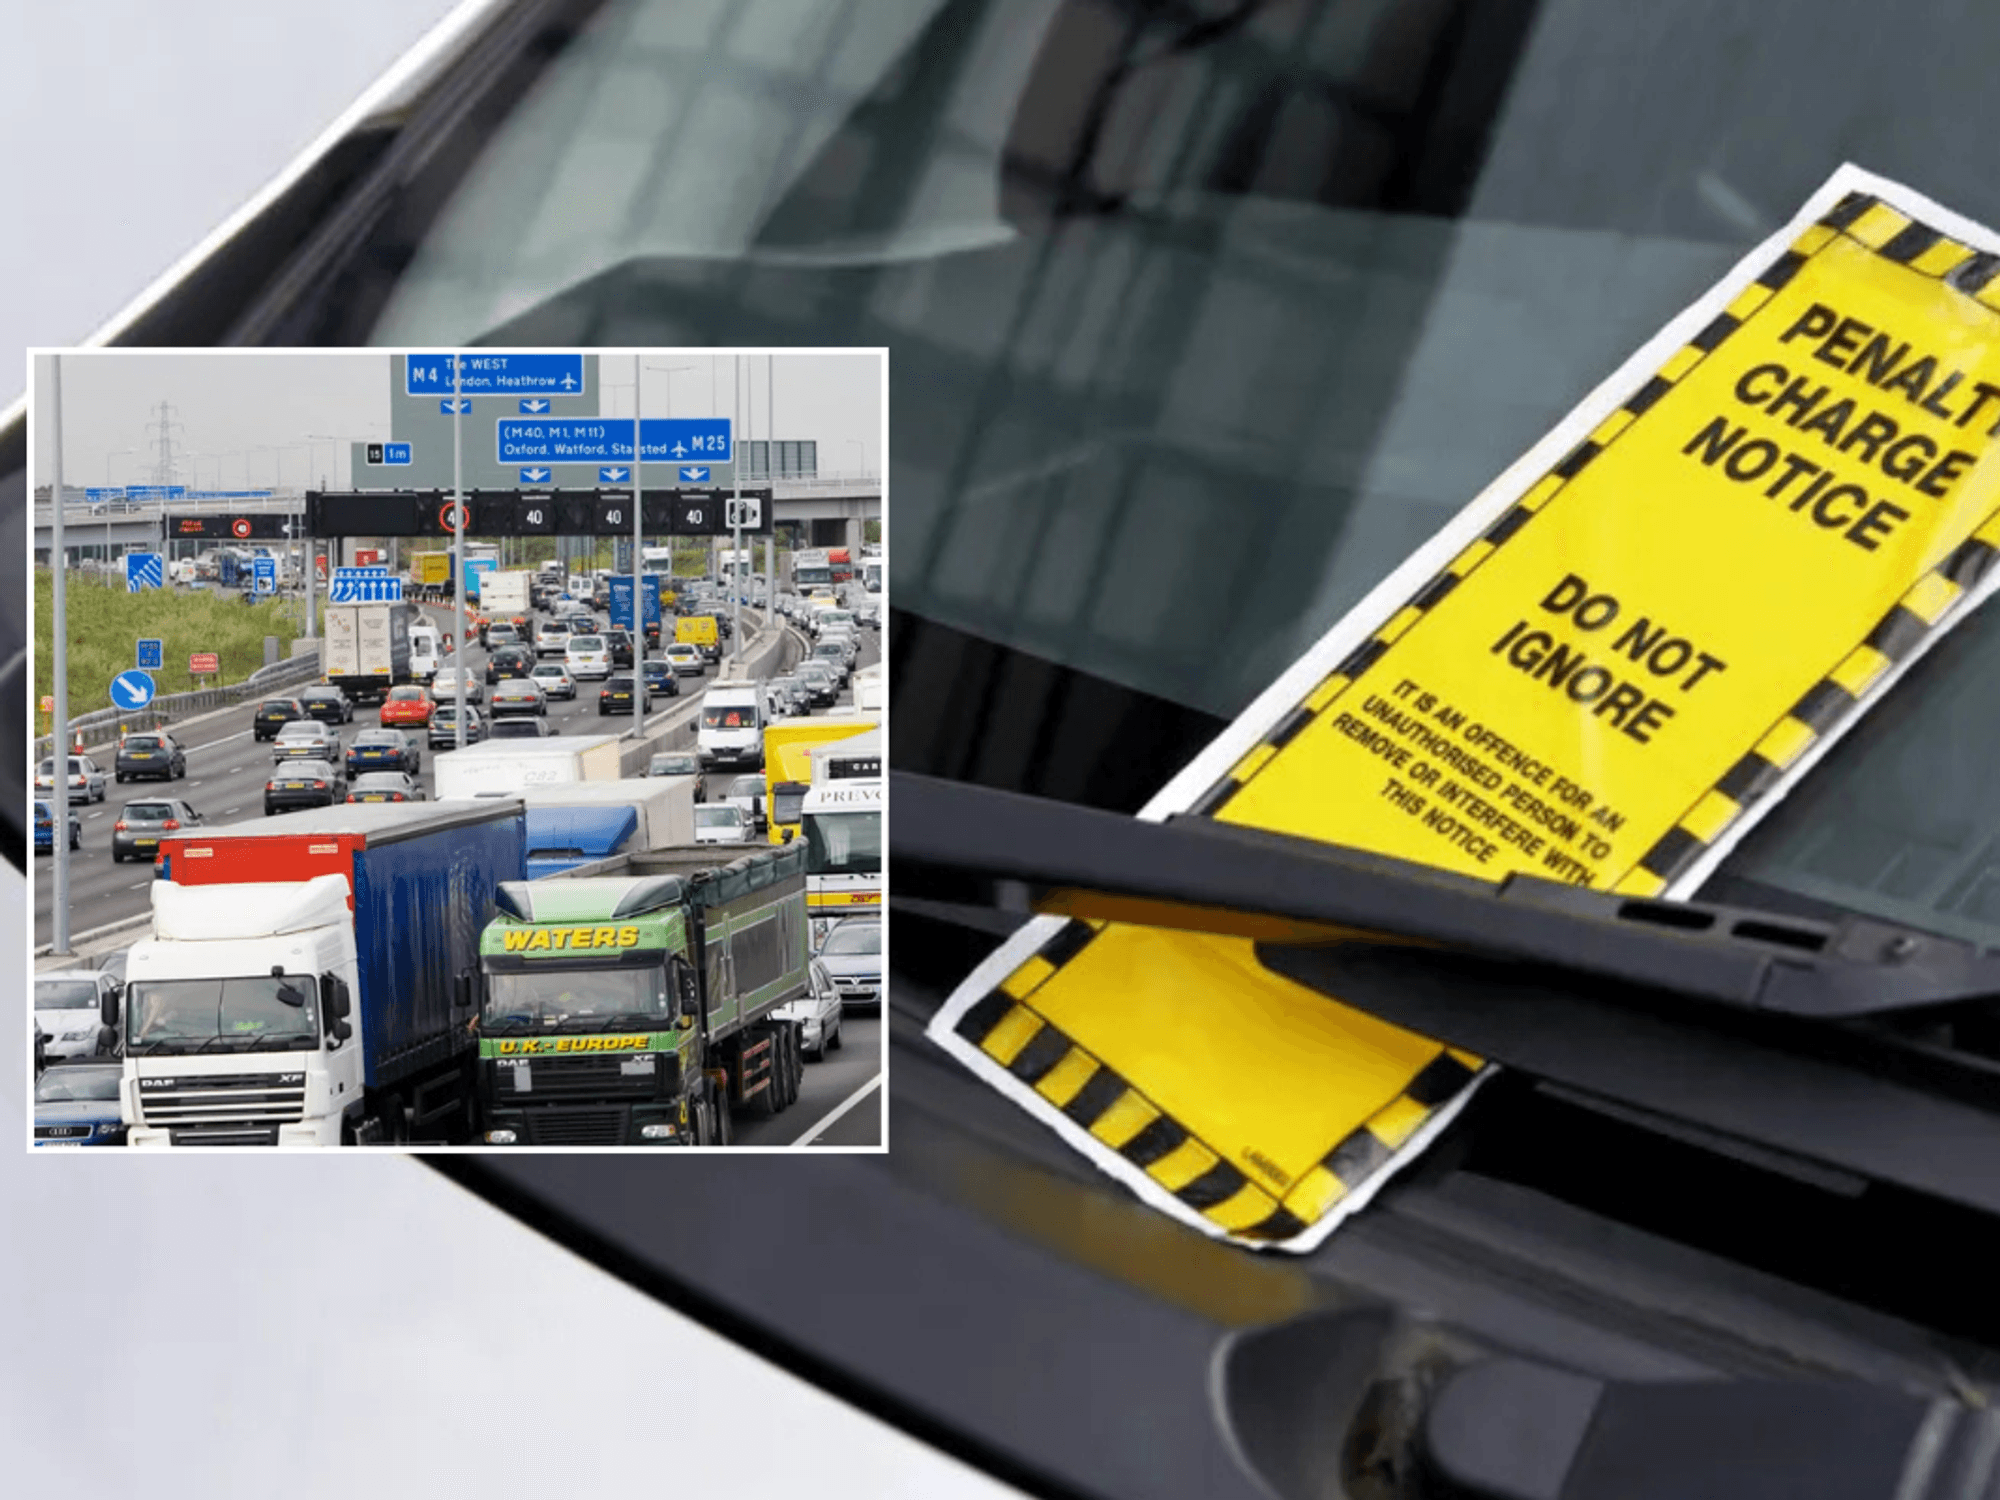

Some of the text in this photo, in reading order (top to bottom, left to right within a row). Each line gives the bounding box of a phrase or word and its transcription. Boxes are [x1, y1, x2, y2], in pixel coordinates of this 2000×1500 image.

[471, 358, 509, 370] WEST
[497, 375, 556, 387] Heathrow
[1778, 302, 2000, 439] PENALT
[504, 443, 667, 455] Oxford, Watford, Stasted
[1734, 363, 1977, 499] CHARGE
[1681, 415, 1911, 552] NOTICE
[526, 509, 543, 525] 40
[606, 509, 622, 525] 40
[686, 509, 703, 525] 40
[1539, 573, 1727, 692] DO NOT
[1490, 620, 1675, 745] IGNORE
[1362, 694, 1613, 861] UNAUTHORISED PERSON TO
[1392, 679, 1627, 834] IT IS AN OFFENCE FOR AN
[1331, 711, 1414, 769] REMOVE
[1408, 761, 1442, 788] OR
[1436, 780, 1547, 858] INTERFERE
[1380, 777, 1499, 864] THIS NOTICE
[503, 926, 638, 950] WATERS
[141, 1079, 175, 1087] DAF
[496, 1058, 529, 1067] DAF
